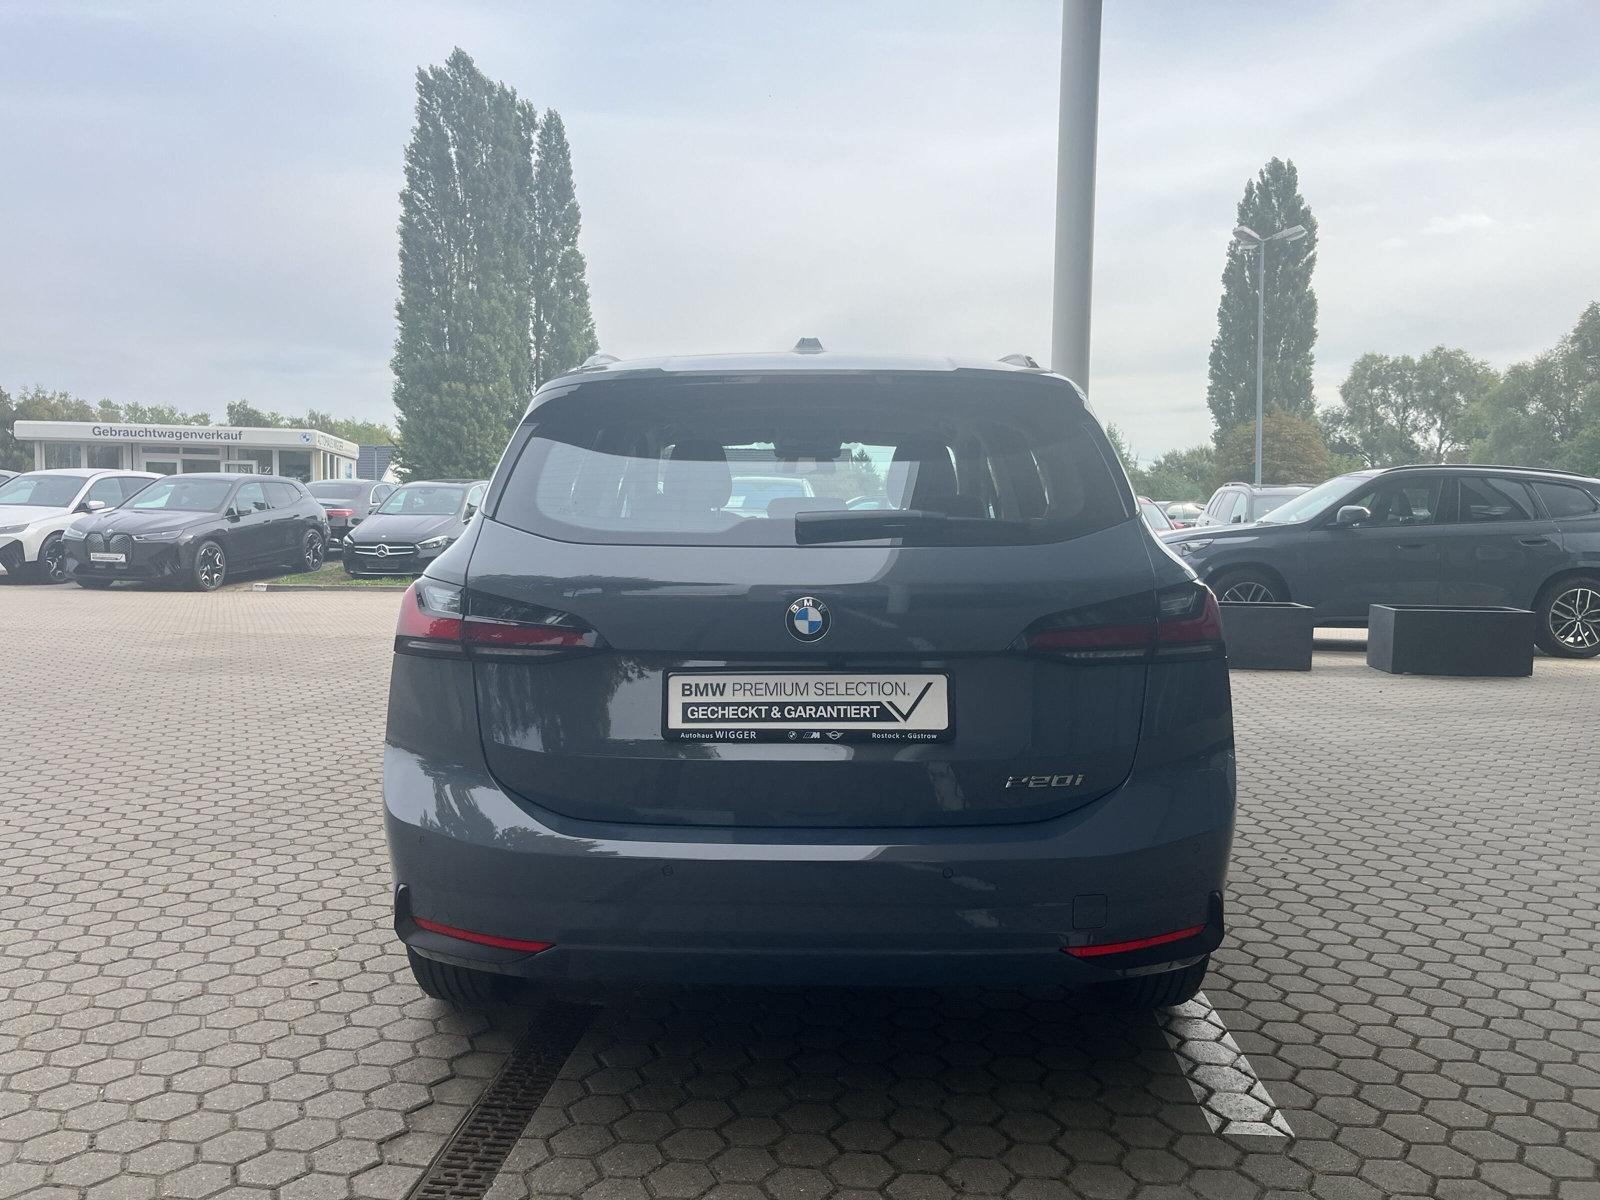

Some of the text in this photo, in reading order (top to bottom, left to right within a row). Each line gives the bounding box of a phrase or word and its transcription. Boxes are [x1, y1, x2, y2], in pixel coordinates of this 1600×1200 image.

[92, 426, 243, 441] Gebrauchtwagenverkauf
[681, 681, 910, 697] BMW PREMIUM SELECTION.
[687, 705, 880, 719] GECHECKT & GARANTIERT
[715, 730, 757, 739] WIGGER
[907, 731, 938, 740] Güstrow
